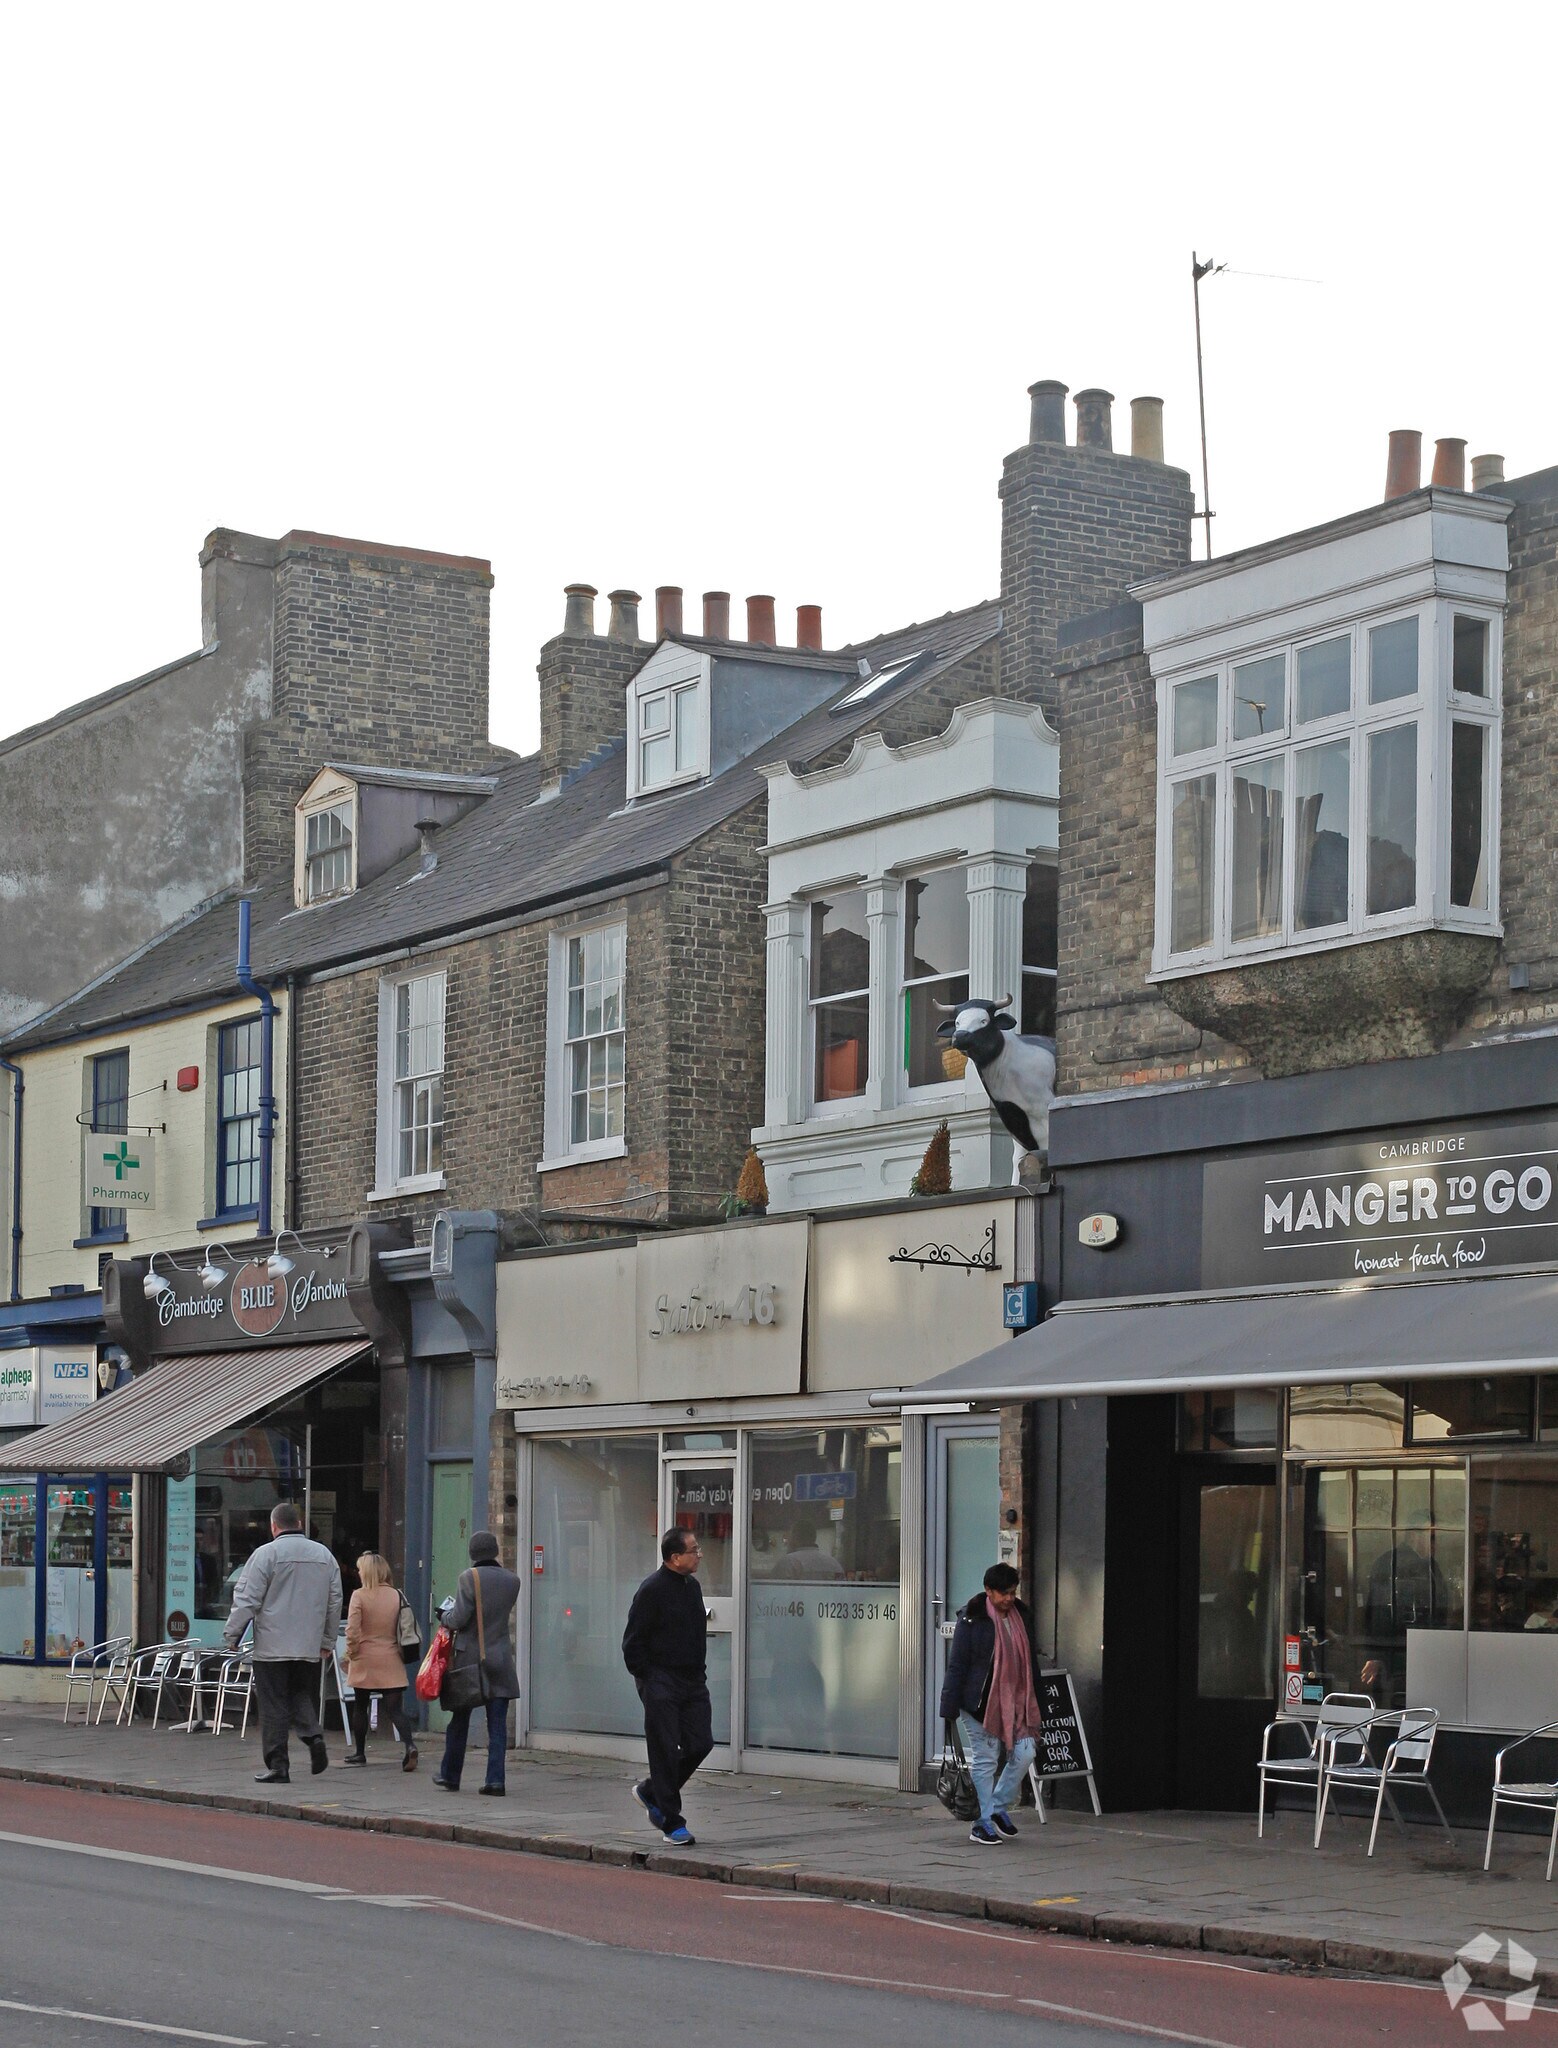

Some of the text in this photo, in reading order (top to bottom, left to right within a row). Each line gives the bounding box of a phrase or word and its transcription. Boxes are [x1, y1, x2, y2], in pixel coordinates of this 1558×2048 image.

[1379, 1137, 1466, 1160] CAMBRIDGE
[92, 1186, 150, 1203] Pharmacy
[1264, 1165, 1552, 1234] MANGER TO GO
[1354, 1237, 1486, 1274] honest fresh food
[156, 1287, 224, 1327] Cambridge
[240, 1284, 276, 1311] BLUE
[729, 1282, 777, 1326] 46
[1005, 1316, 1025, 1325] ALARM
[1, 1367, 32, 1388] alphega
[55, 1364, 87, 1378] NHS
[817, 1602, 849, 1620] 01223
[851, 1603, 865, 1620] 35
[867, 1603, 879, 1620] 31
[883, 1604, 897, 1621] 46
[170, 1621, 186, 1632] BLUE
[1047, 1746, 1074, 1761] BAR
